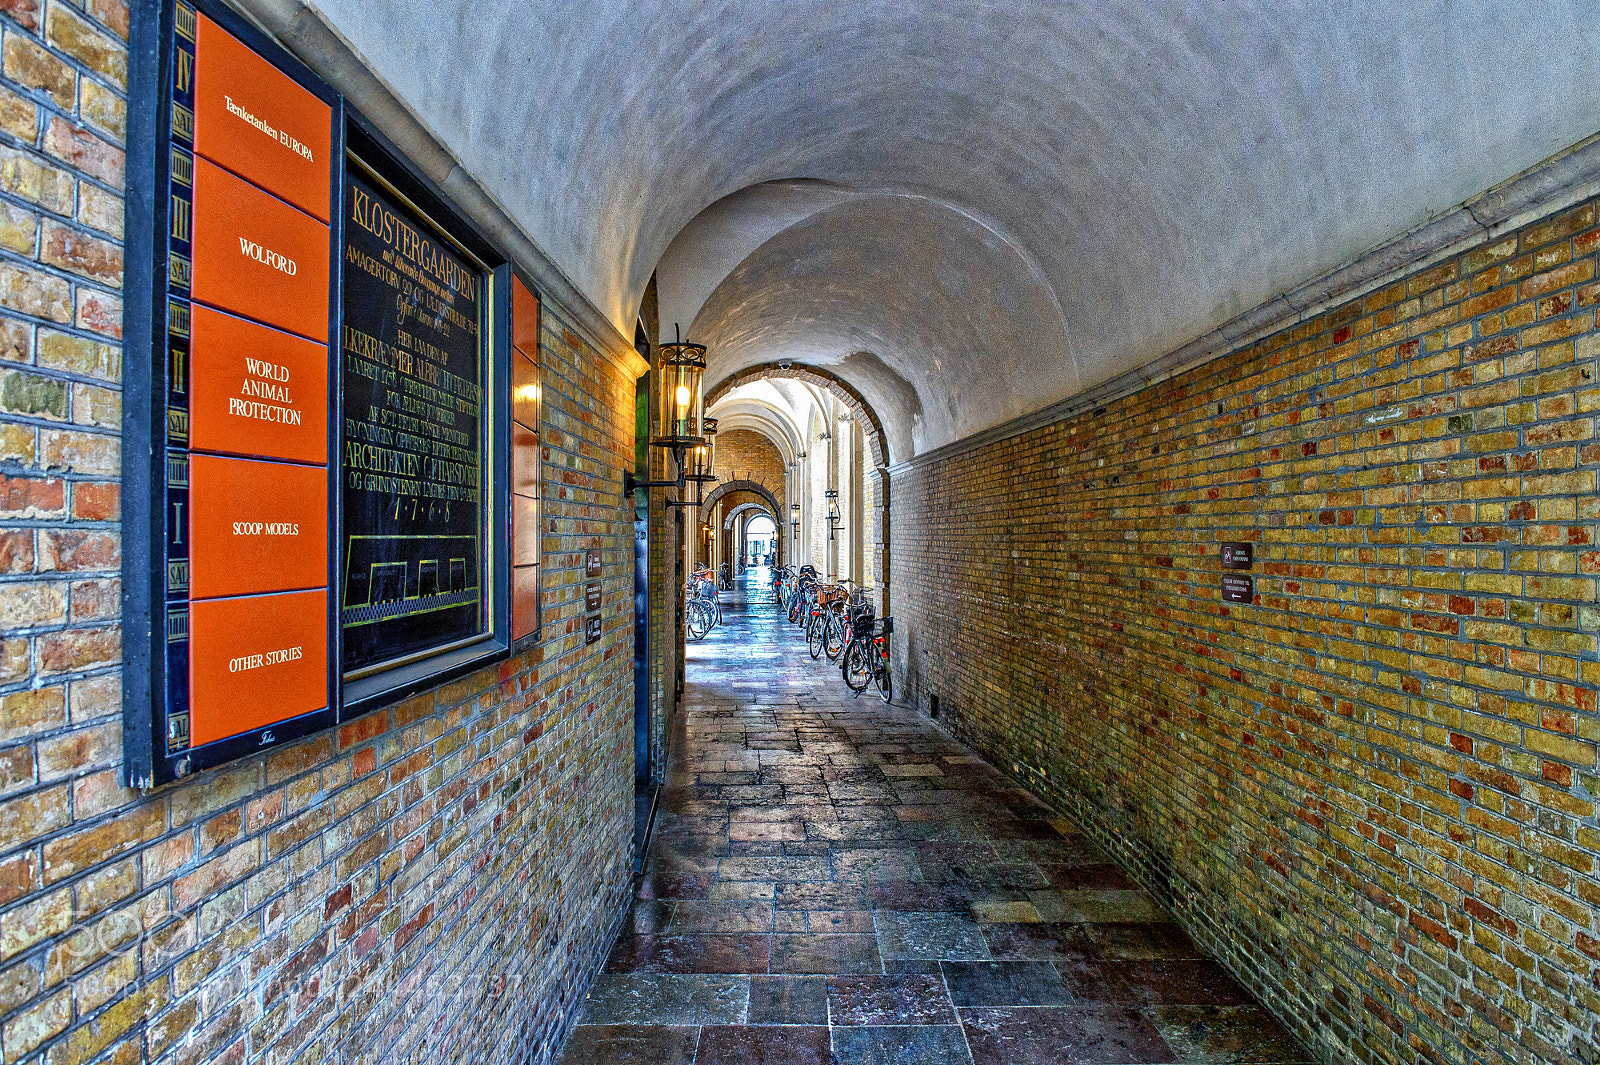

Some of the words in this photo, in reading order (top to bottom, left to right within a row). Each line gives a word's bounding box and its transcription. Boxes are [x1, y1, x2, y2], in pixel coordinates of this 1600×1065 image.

[224, 95, 278, 140] Tænketanken
[279, 130, 314, 163] EUROPA
[239, 236, 297, 276] WOLFORD
[352, 186, 475, 303] KLOSTERGAARDEN
[346, 244, 400, 290] AMAGERTORV
[245, 357, 289, 383] WORLD
[241, 378, 293, 404] ANIMAL
[169, 414, 188, 435] SAL
[229, 397, 302, 426] PROTECTION
[343, 441, 421, 477] ARCHITEKTEN
[233, 522, 263, 535] SCOOP
[265, 522, 299, 536] MODELS
[169, 565, 188, 585] SAL
[229, 654, 264, 673] OTHER
[266, 646, 302, 666] STORIES
